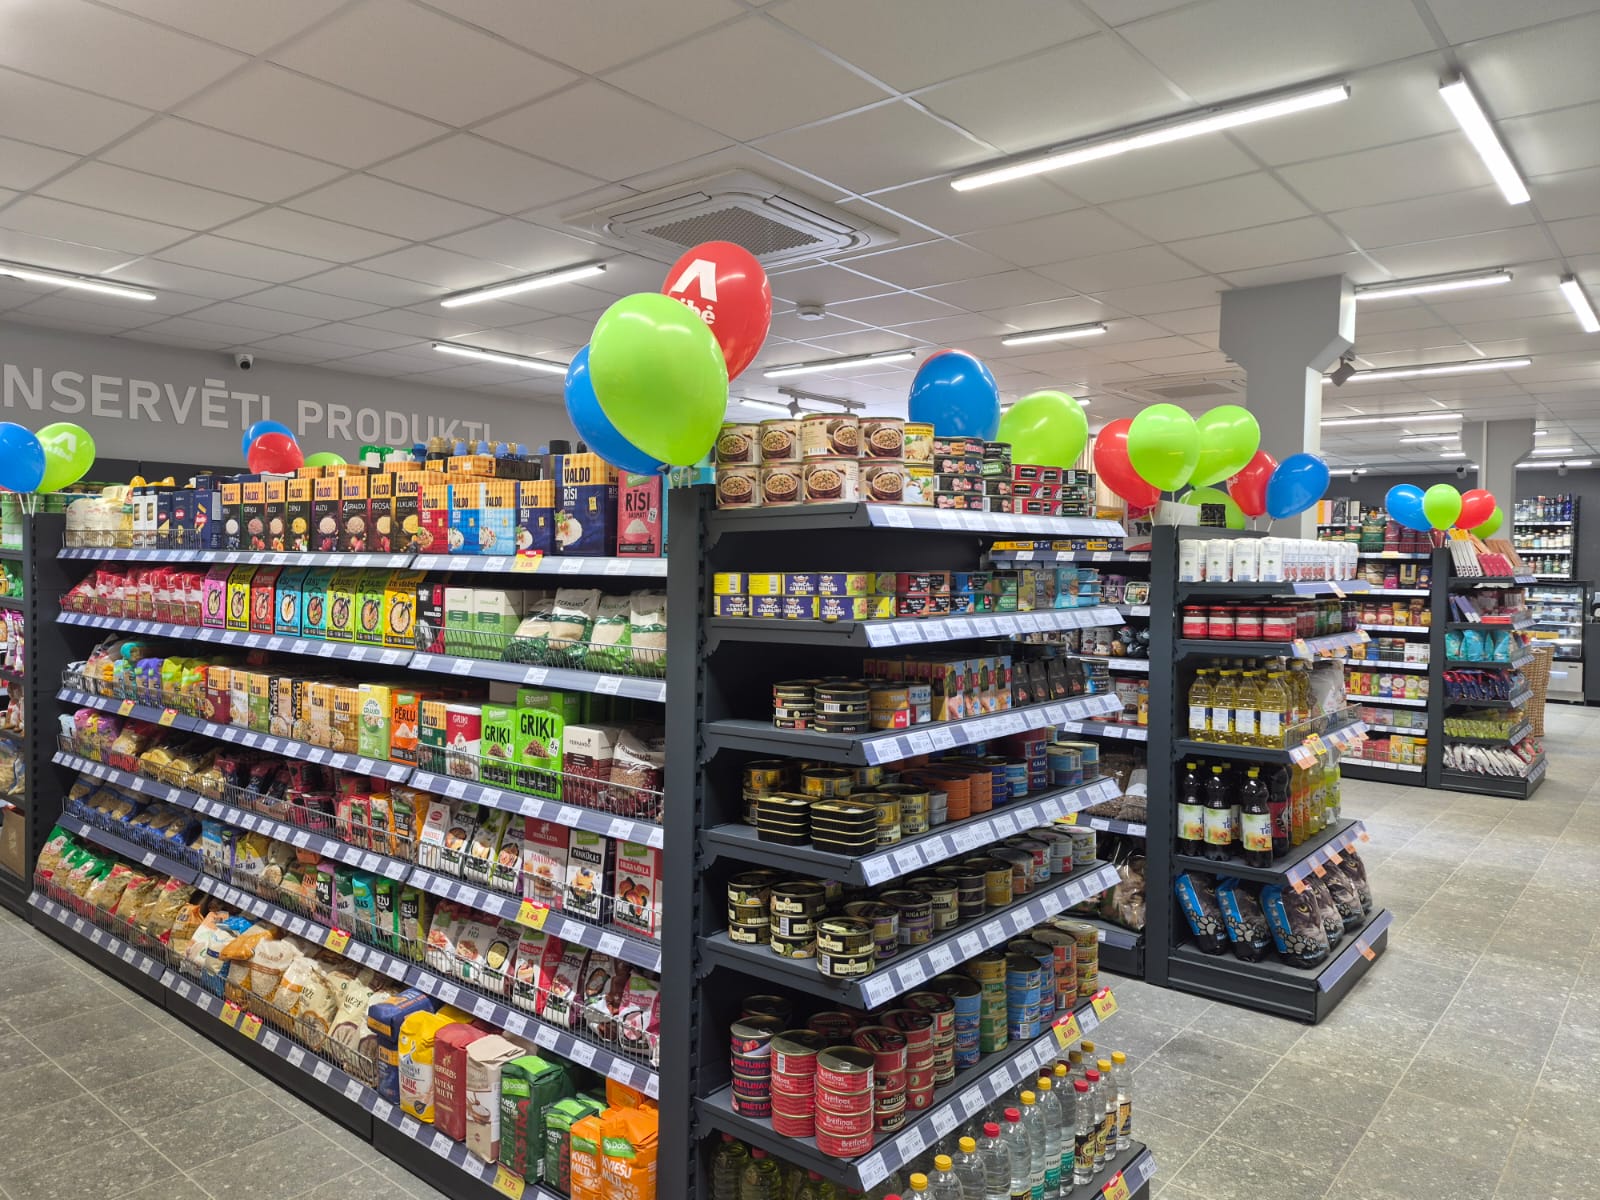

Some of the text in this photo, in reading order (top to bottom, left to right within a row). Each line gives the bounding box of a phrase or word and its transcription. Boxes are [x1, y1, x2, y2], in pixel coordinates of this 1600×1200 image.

[297, 399, 491, 446] PRODUKTI
[564, 467, 591, 483] VALDO
[625, 490, 651, 511] RĪSI
[520, 714, 555, 742] GRIĶI
[514, 1100, 531, 1177] EKSTRA
[602, 1155, 632, 1179] KVIEŠU
